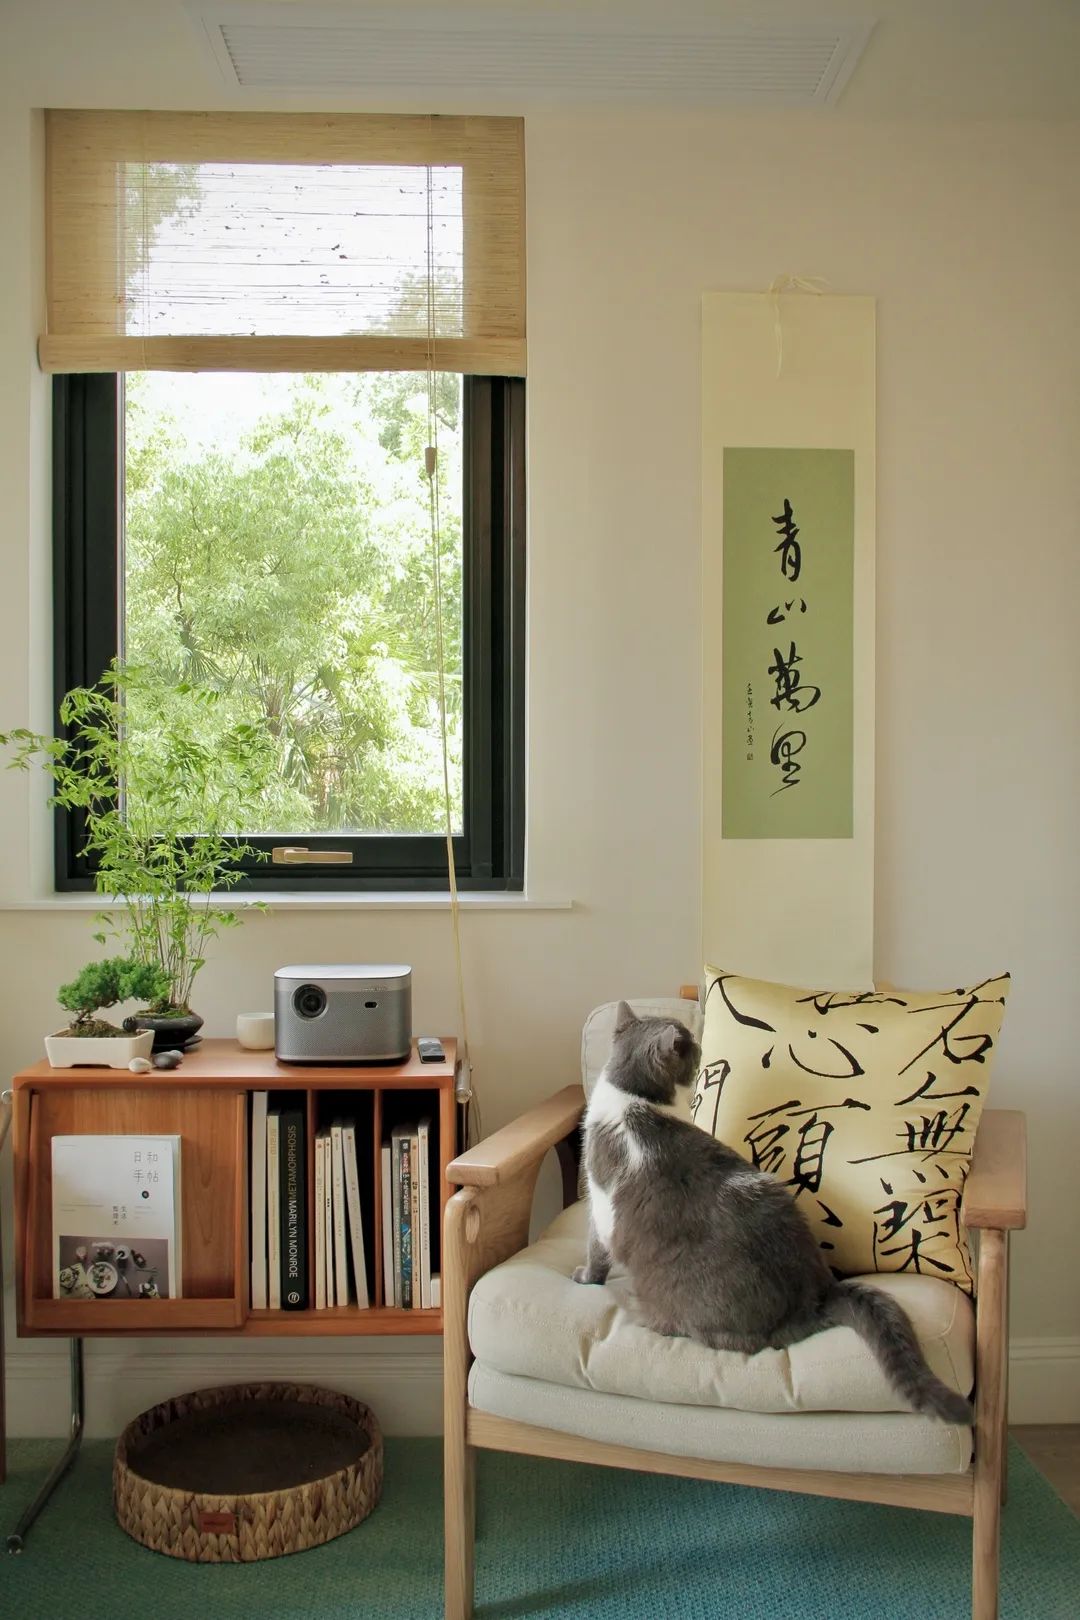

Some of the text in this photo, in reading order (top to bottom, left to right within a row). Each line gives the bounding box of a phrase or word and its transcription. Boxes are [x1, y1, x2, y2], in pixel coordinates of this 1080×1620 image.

[288, 1125, 297, 1199] METAMORPHOSIS
[289, 1200, 298, 1278] MARILYN MONROE
